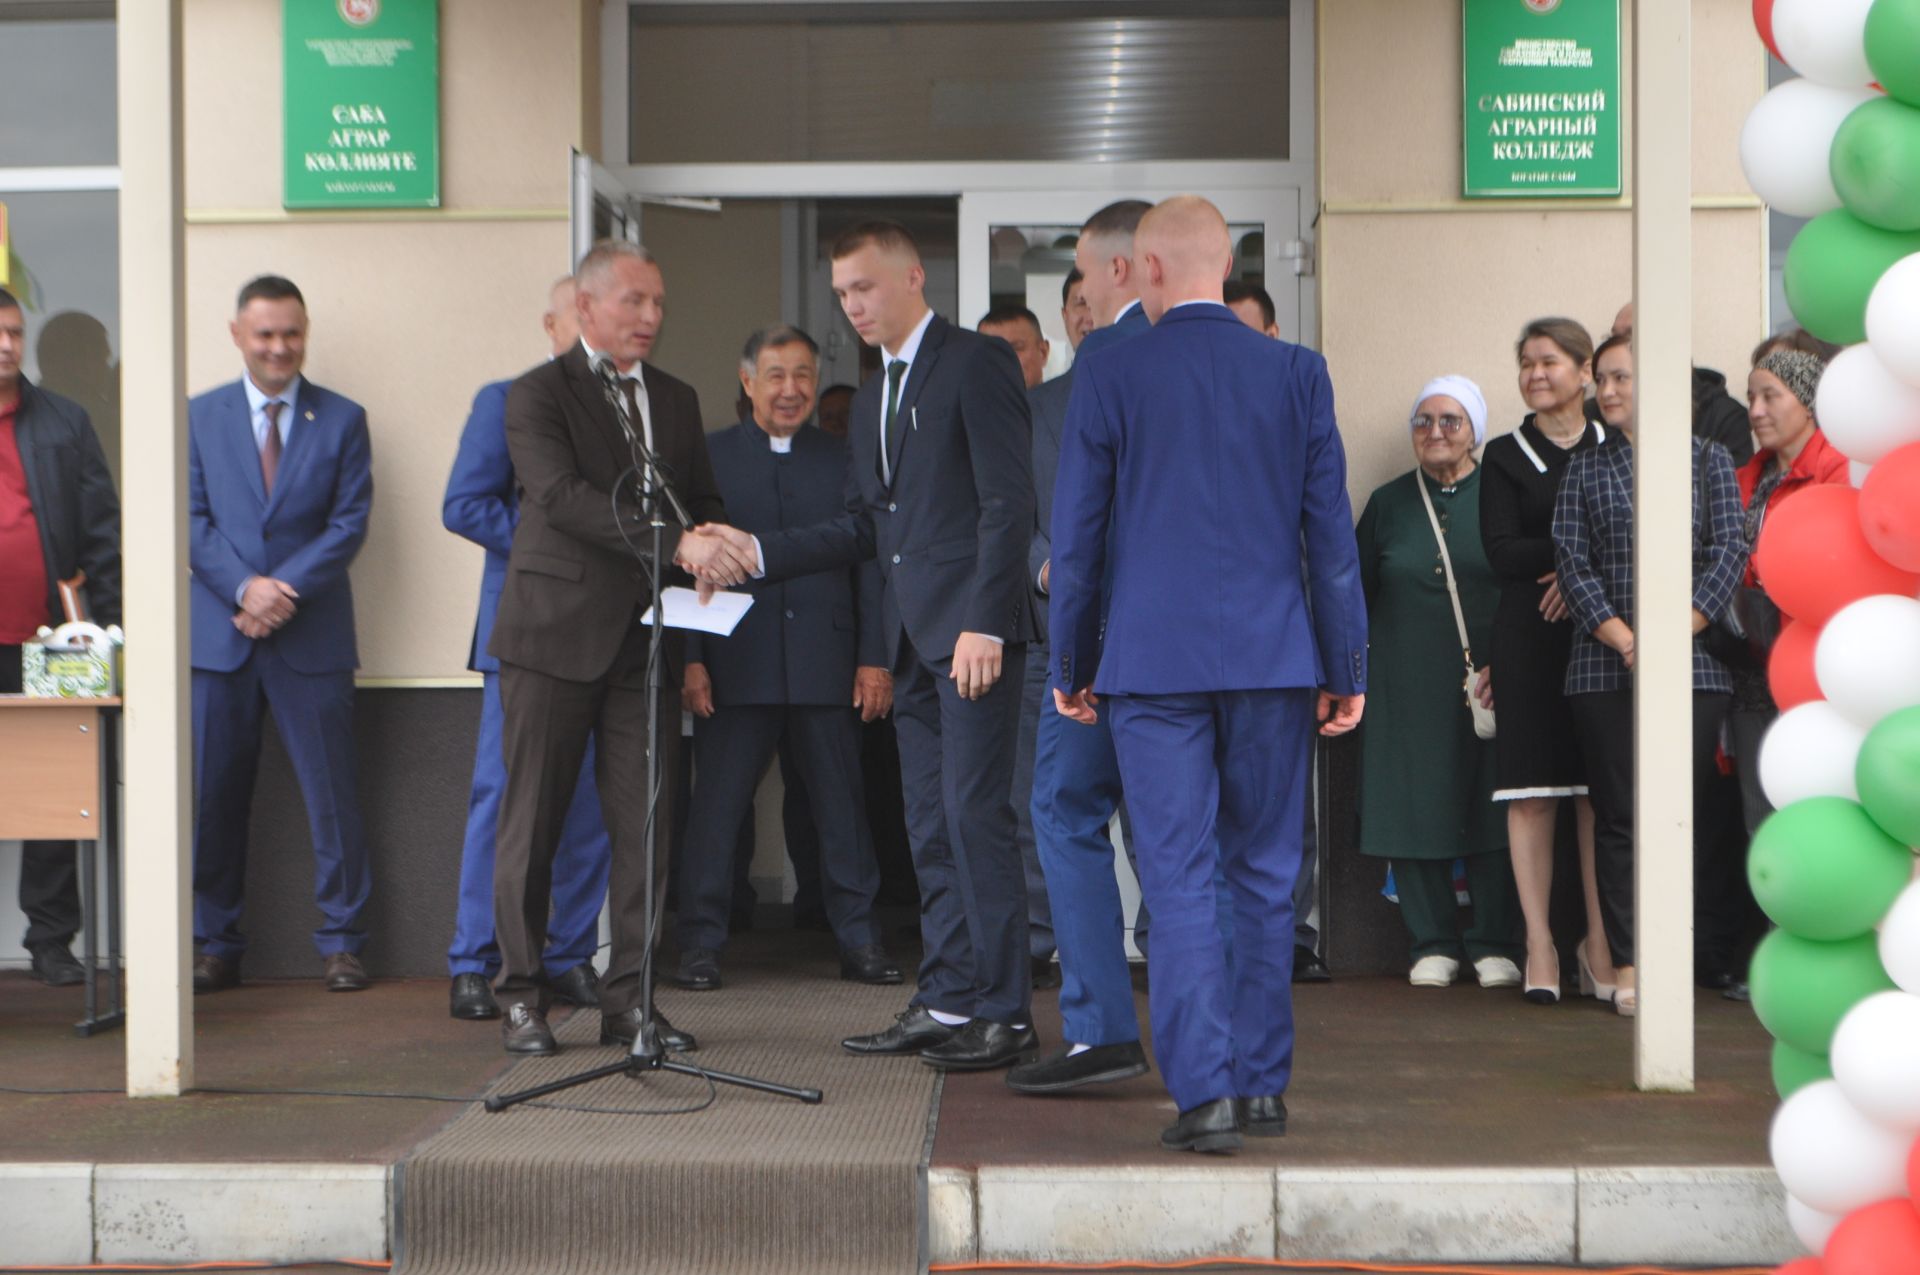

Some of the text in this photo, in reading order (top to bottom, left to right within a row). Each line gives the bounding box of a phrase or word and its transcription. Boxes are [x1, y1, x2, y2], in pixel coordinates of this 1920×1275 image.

[1478, 89, 1605, 112] САБИНСКИЙ
[332, 104, 387, 124] САБА
[1488, 114, 1597, 136] АГРАРНЫЙ
[328, 128, 391, 148] АГРАР
[1493, 141, 1594, 161] КОЛЛЕДЖ
